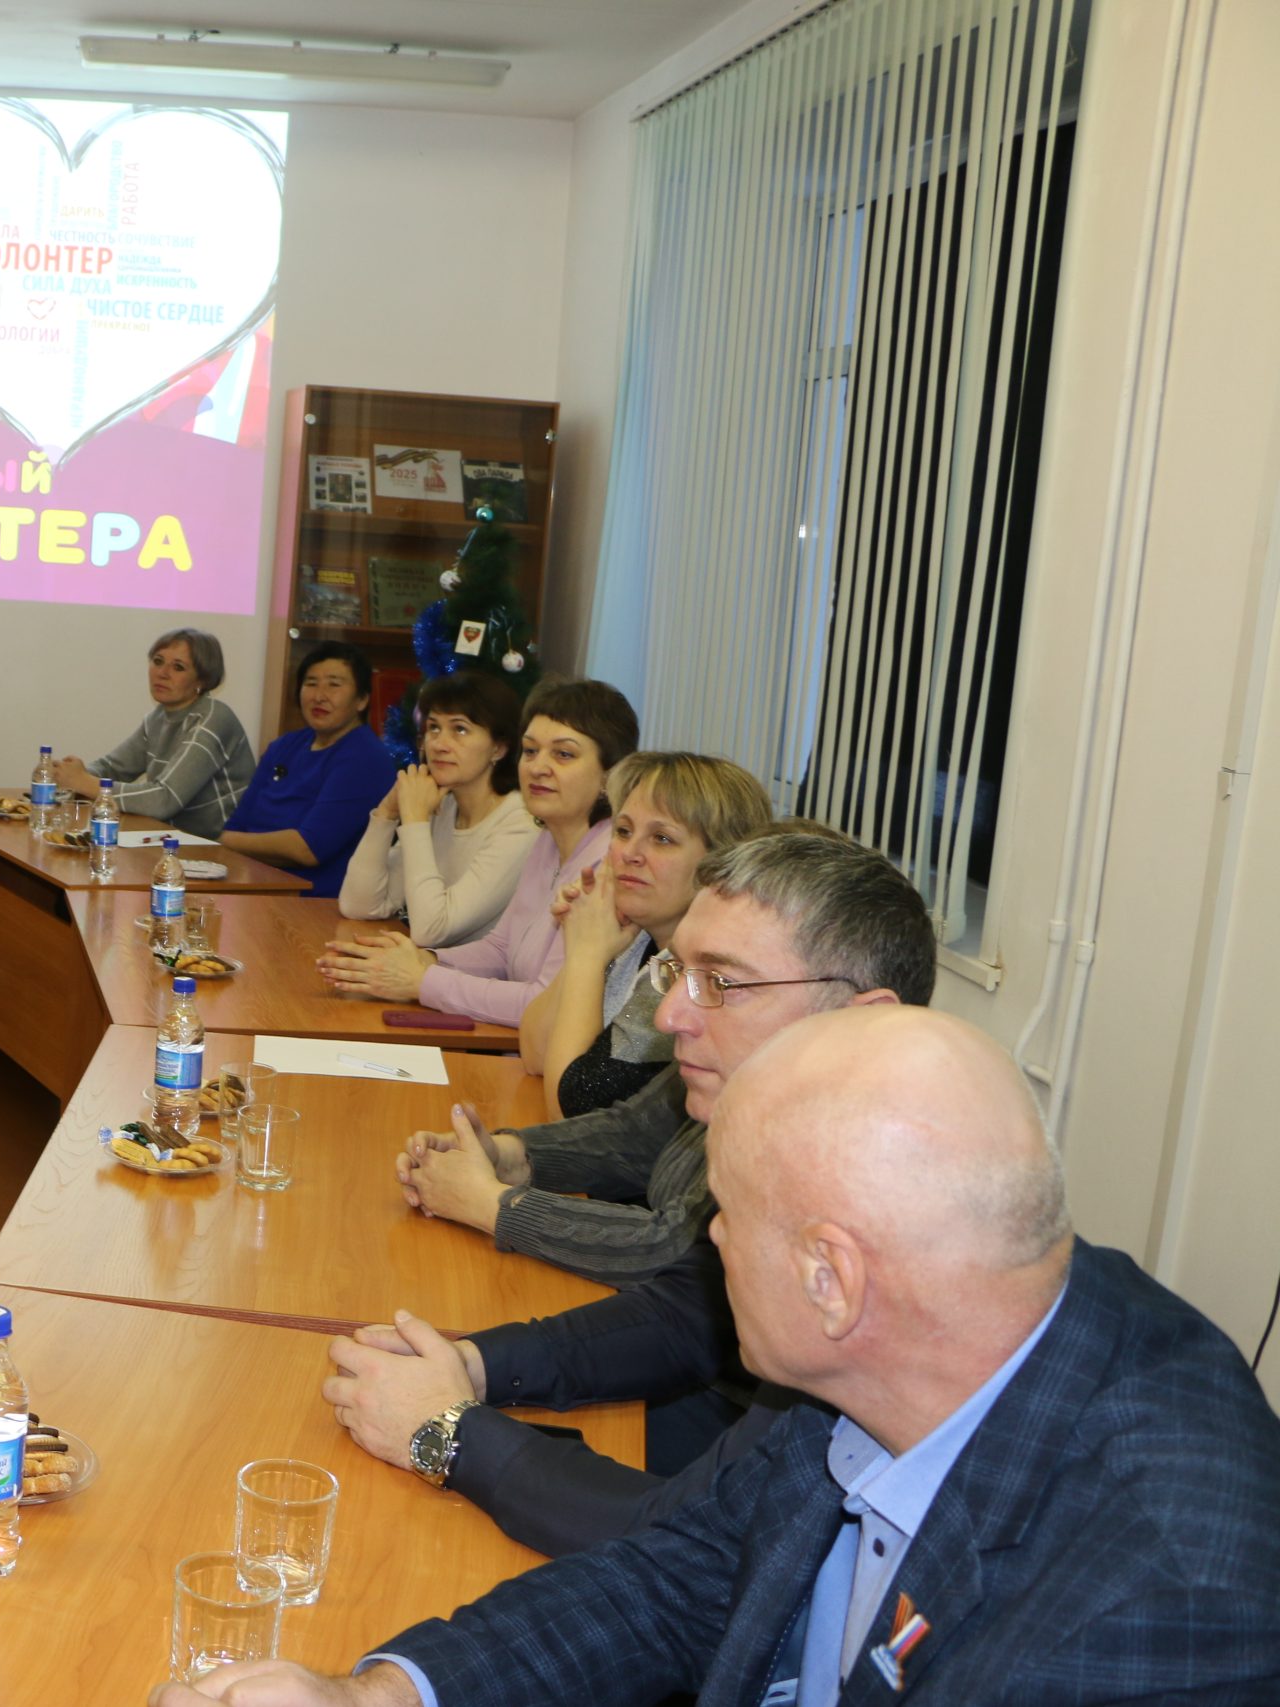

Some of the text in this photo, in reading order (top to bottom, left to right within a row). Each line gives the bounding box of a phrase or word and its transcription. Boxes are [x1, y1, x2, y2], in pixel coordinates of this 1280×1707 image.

[122, 160, 140, 226] РАБОТА
[60, 205, 105, 218] ДАРИТЬ
[49, 230, 116, 245] ЧЕСТНОСТЬ
[118, 232, 196, 249] СОЧУВСТВИЕ
[22, 274, 66, 292] СИЛА
[69, 277, 113, 296] ДУХА
[116, 273, 198, 290] ИСКРЕННОСТЬ
[87, 298, 225, 327] ЧИСТОЕ СЕРДЦЕ
[390, 468, 418, 480] 2025
